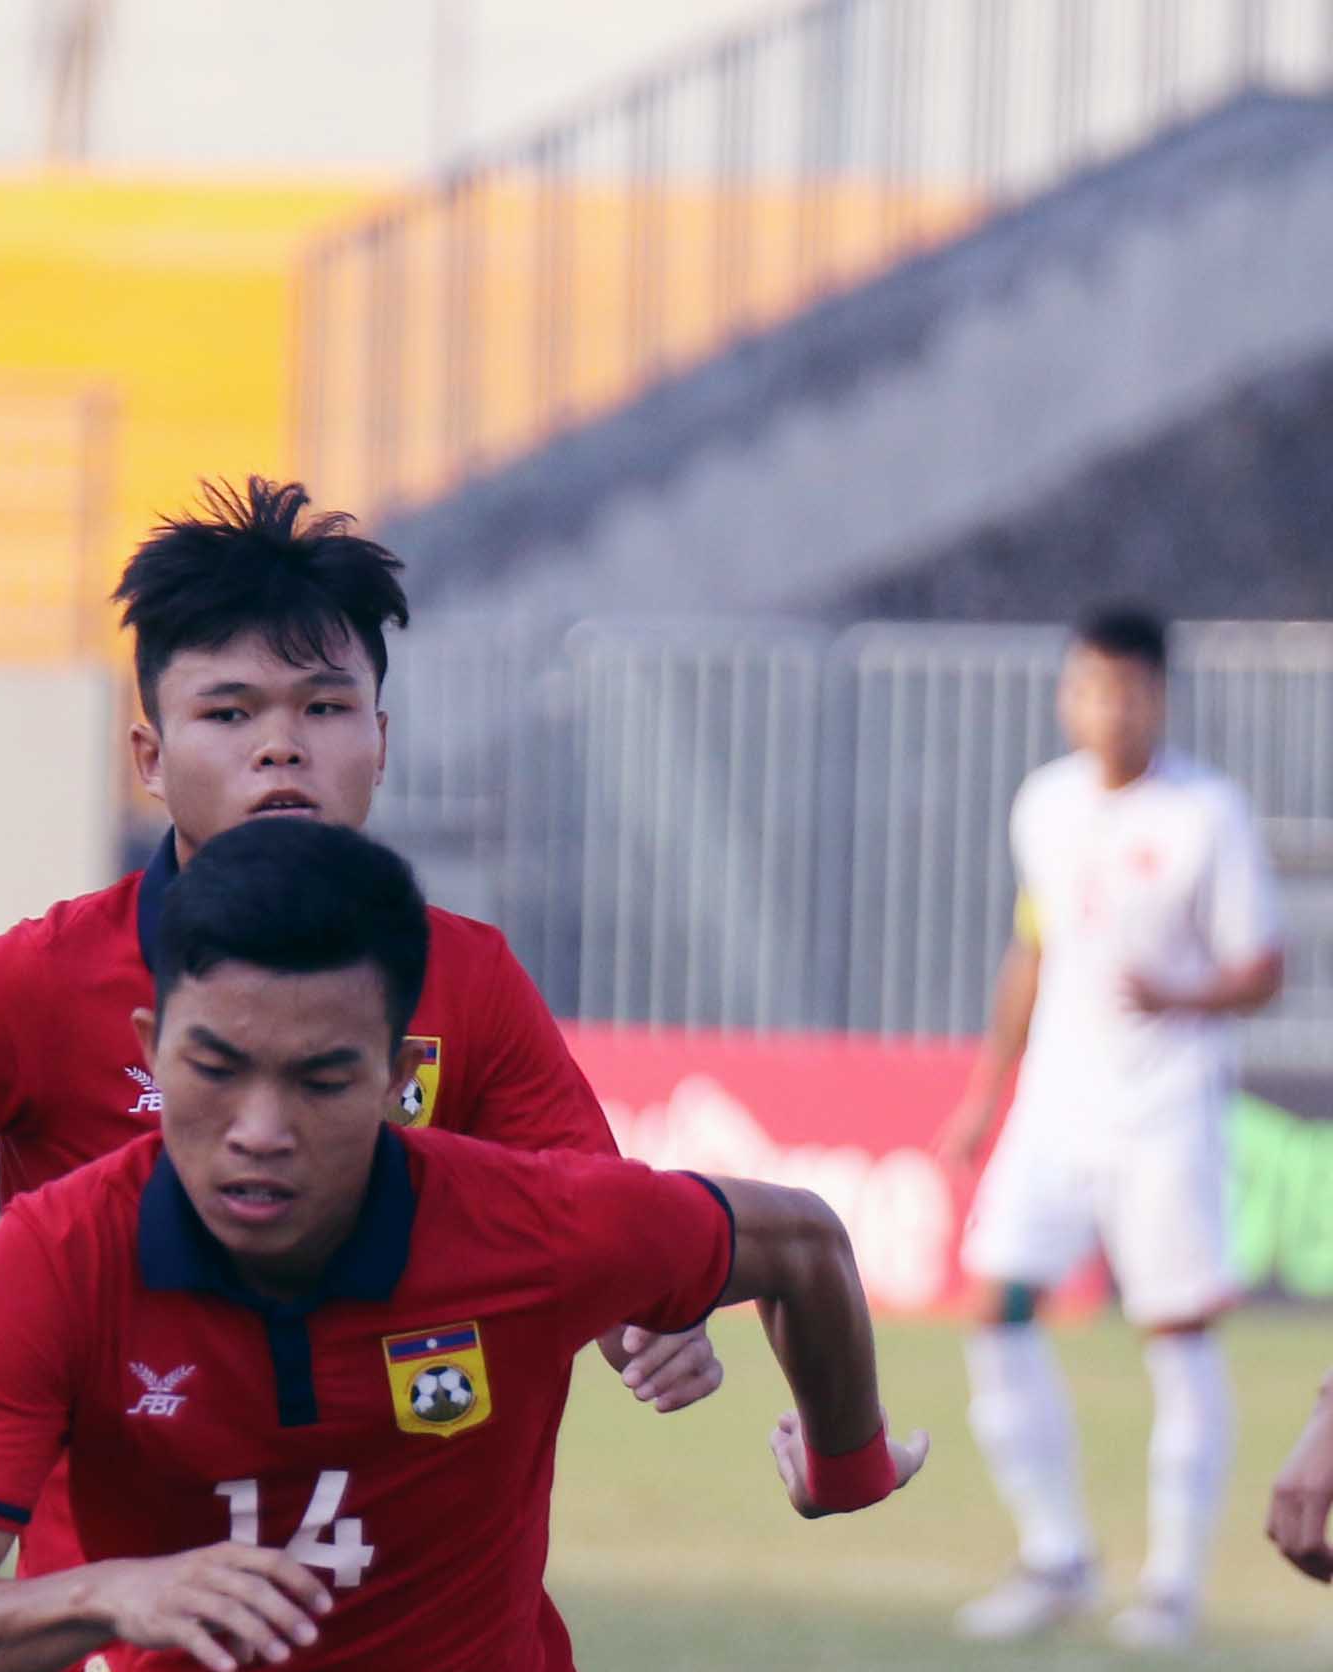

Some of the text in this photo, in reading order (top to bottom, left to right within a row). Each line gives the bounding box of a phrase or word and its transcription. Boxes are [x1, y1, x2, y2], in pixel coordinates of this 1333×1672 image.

[128, 1092, 165, 1112] FB
[126, 1393, 188, 1416] FBT
[214, 1469, 376, 1588] 14
